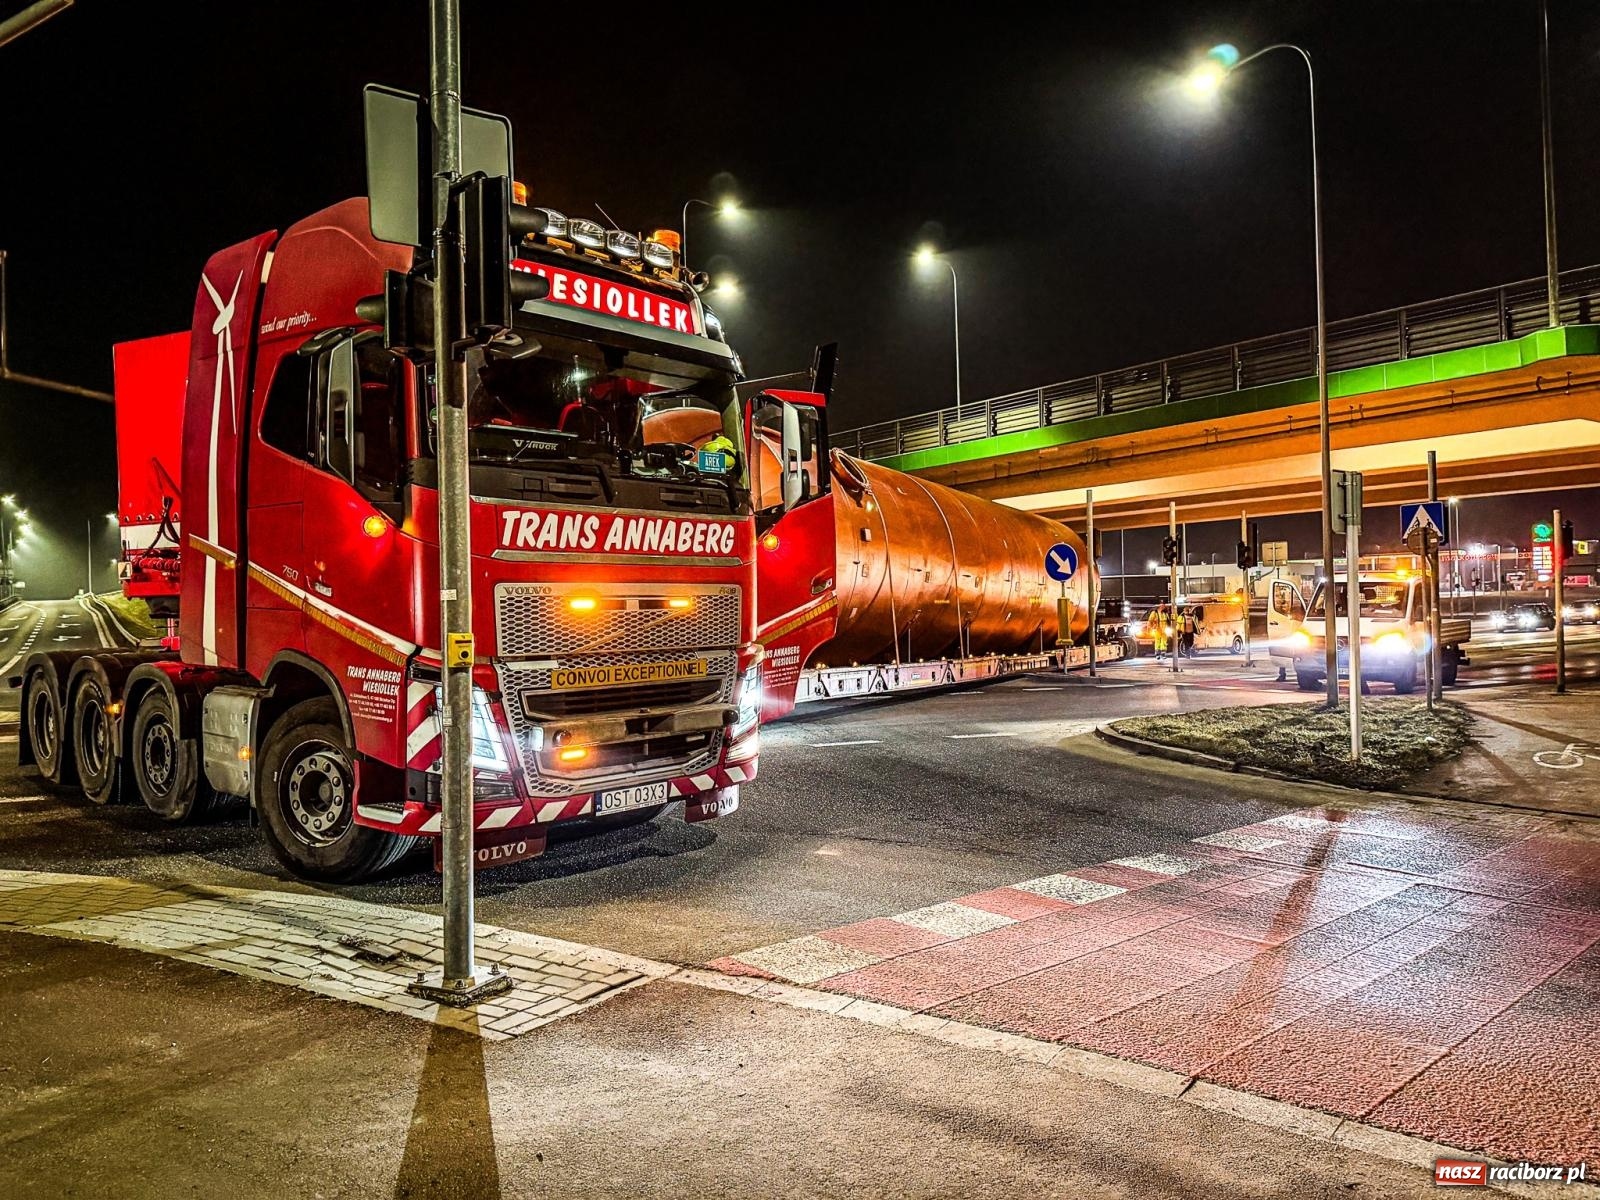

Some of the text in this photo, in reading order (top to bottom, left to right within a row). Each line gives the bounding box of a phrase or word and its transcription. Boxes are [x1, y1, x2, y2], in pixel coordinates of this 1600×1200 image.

[509, 264, 688, 332] ESIOLLEK
[502, 510, 735, 554] TRANS ANNABERG
[282, 564, 299, 581] 750
[503, 586, 552, 595] VOLVO
[347, 665, 401, 683] TRANS ANNABERG
[556, 660, 703, 686] CONVOI EXCEPTIONNEL
[362, 680, 400, 696] WIESIOLLEK
[604, 789, 630, 809] OST
[634, 784, 665, 803] 03X3
[473, 841, 527, 862] OLVO
